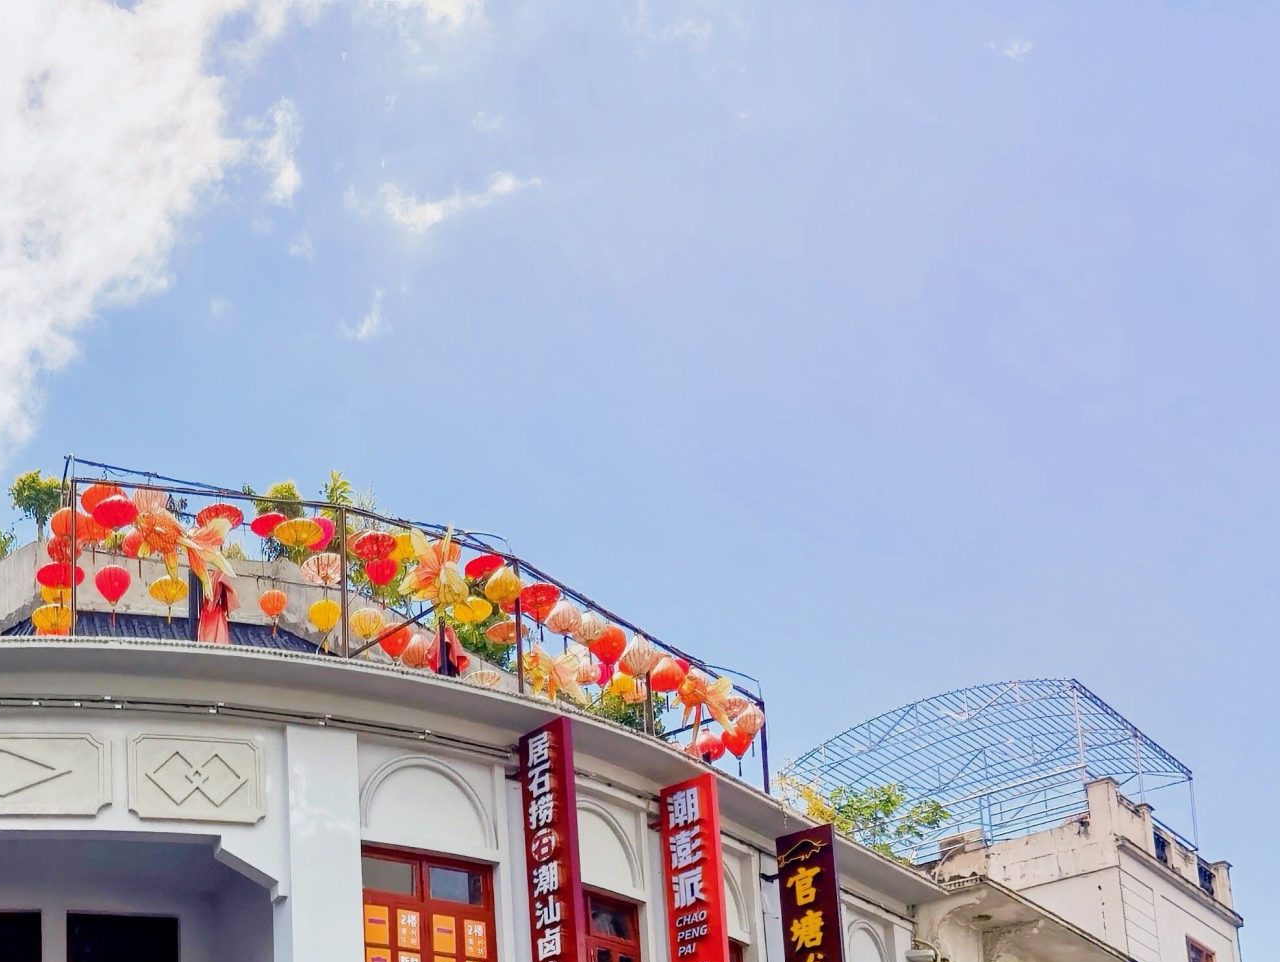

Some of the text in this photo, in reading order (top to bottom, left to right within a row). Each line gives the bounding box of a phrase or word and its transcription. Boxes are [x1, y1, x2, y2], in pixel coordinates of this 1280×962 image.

[676, 910, 707, 927] CHAO
[677, 925, 707, 942] PENG
[678, 942, 696, 957] PAI
